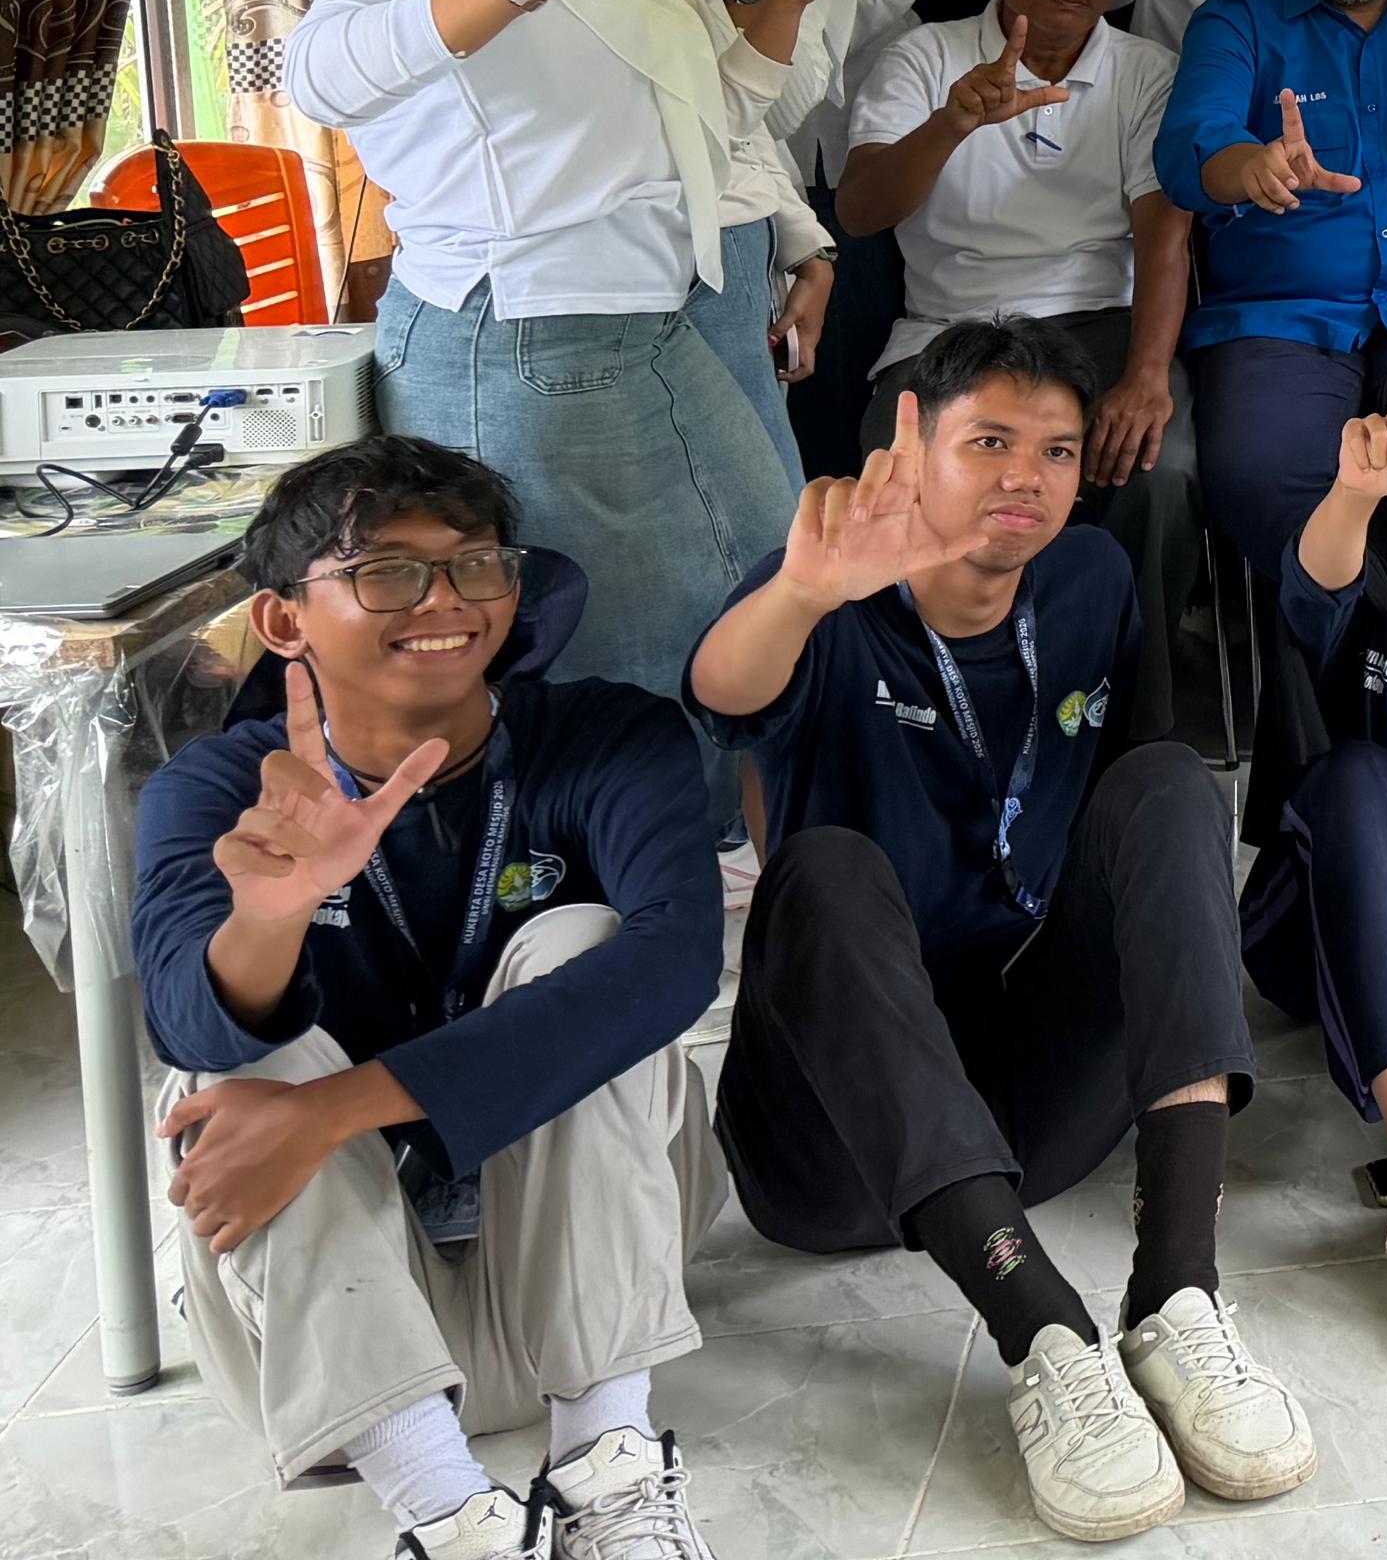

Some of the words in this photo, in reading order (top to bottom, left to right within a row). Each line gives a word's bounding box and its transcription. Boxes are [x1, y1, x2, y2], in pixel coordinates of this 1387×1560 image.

[1310, 92, 1326, 102] LBS
[946, 665, 960, 686] DESA
[954, 685, 969, 710] KOTO
[962, 710, 978, 739] MESJID
[487, 802, 504, 838] MESJID
[480, 839, 496, 868] KOTO
[375, 868, 393, 894] KOTO
[473, 868, 487, 896] DESA
[463, 896, 482, 944] KUKERTA
